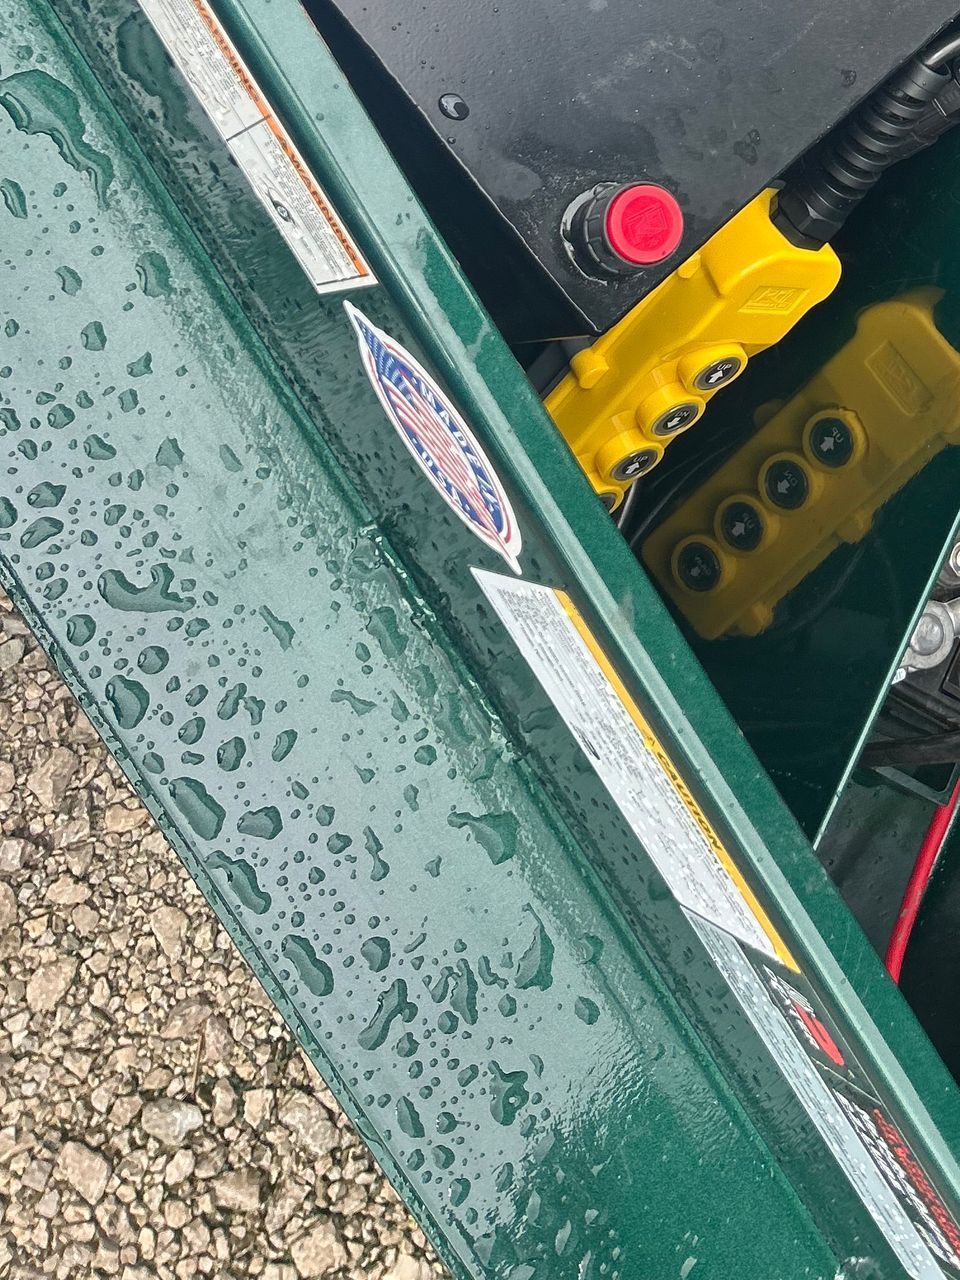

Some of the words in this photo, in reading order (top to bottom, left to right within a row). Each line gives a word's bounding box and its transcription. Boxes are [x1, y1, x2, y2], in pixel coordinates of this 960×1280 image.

[288, 152, 359, 261] WARNING
[717, 363, 732, 371] UP
[654, 752, 724, 851] CAUTION
